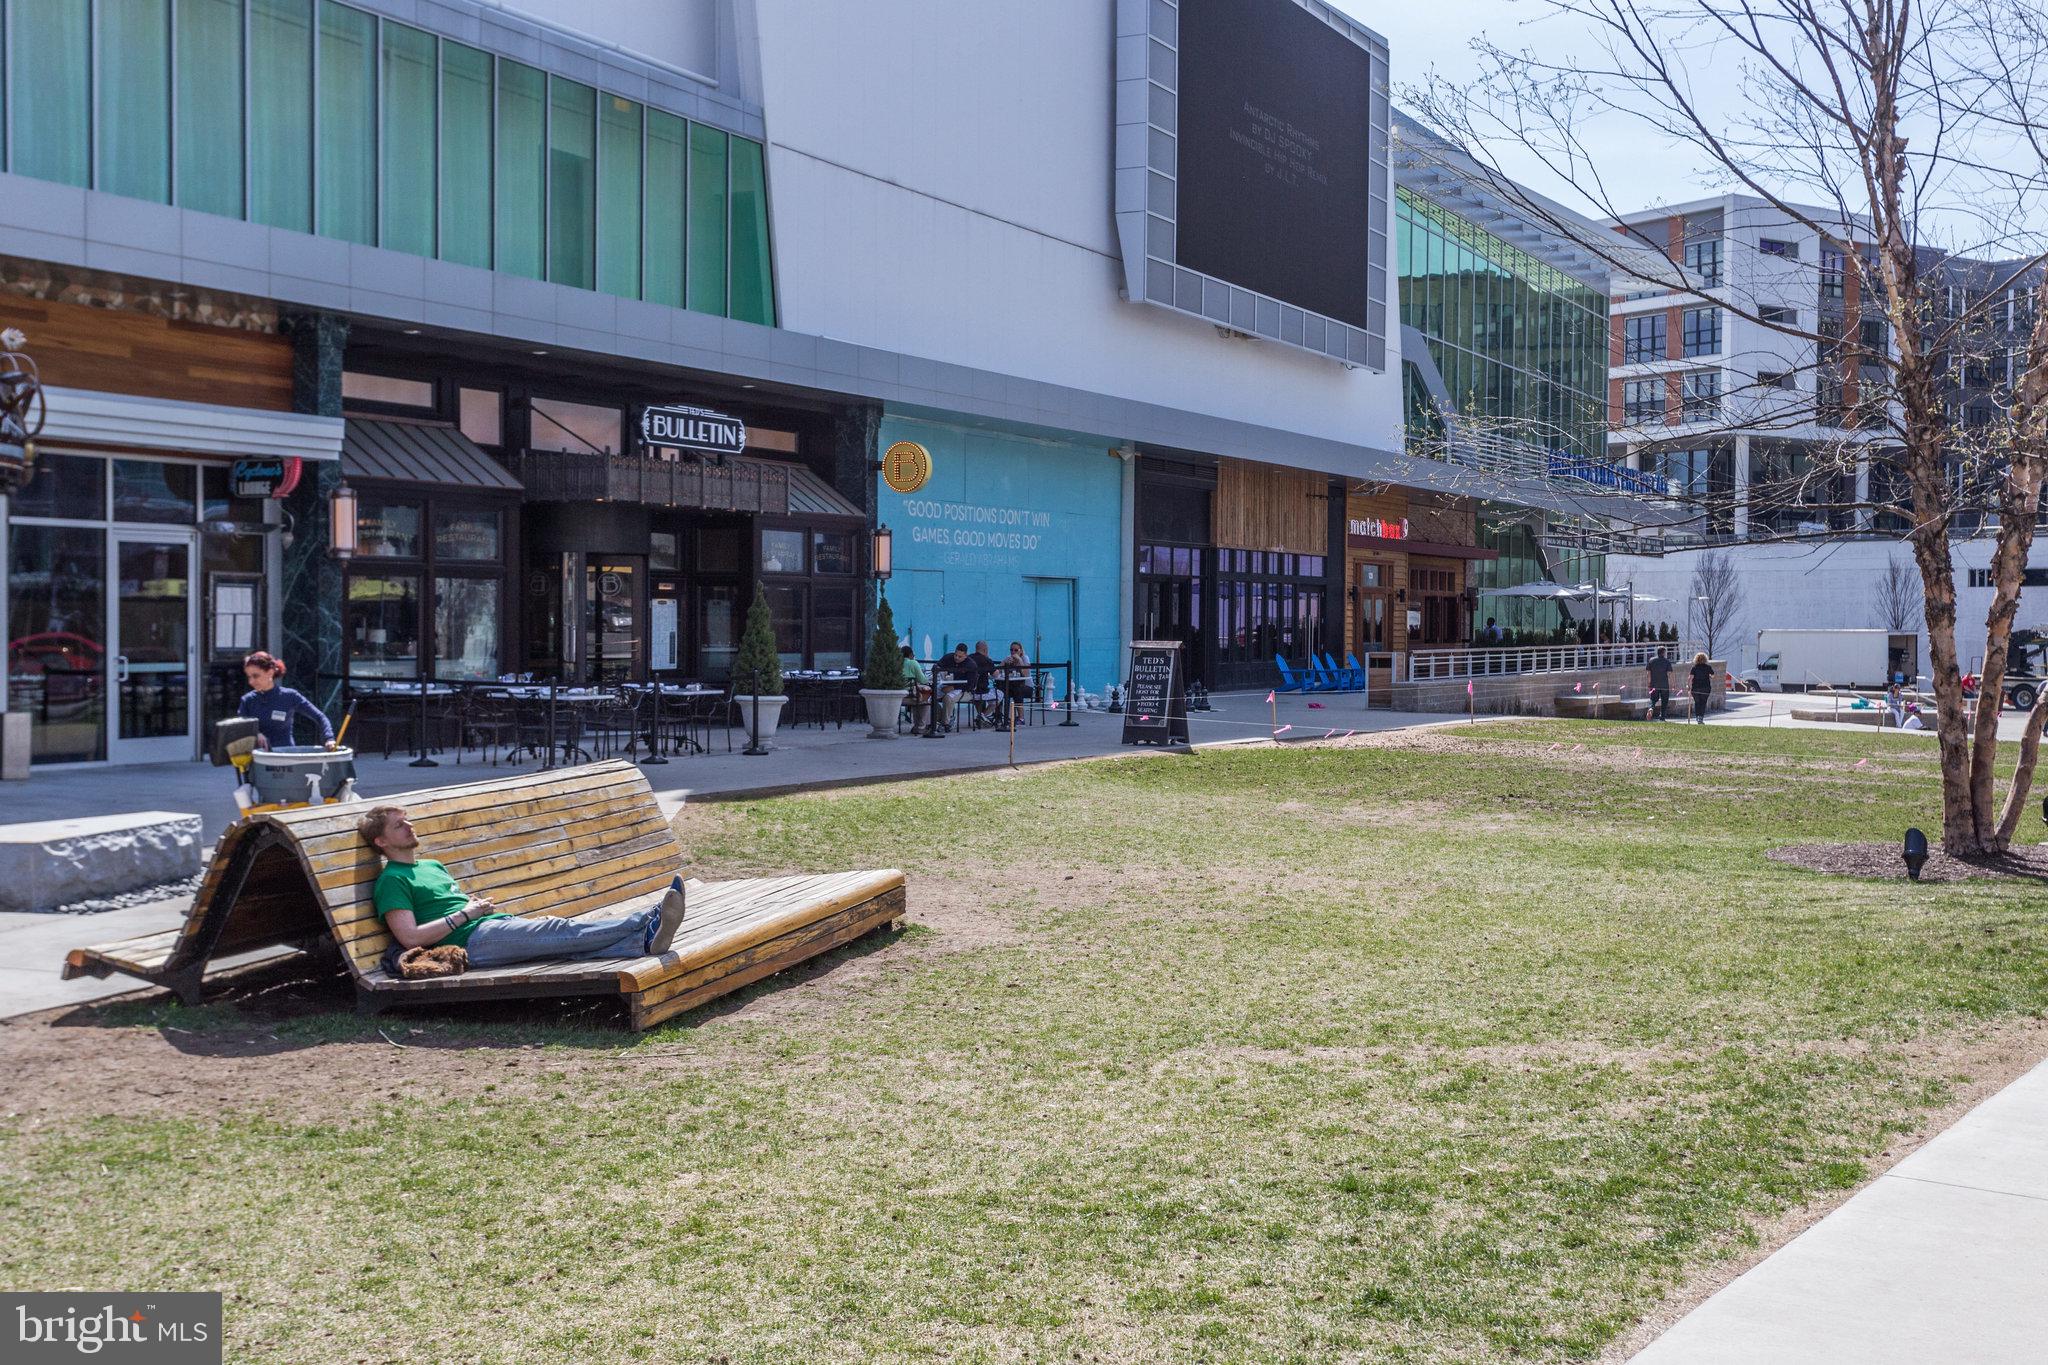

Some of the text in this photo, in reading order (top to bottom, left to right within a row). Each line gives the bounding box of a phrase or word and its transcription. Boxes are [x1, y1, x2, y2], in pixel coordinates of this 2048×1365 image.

[1279, 135, 1312, 160] SPOOKY
[653, 415, 736, 446] BULLETIN
[894, 451, 919, 482] B
[944, 503, 997, 524] POSITIONS
[1000, 508, 1030, 526] DON'T
[1032, 512, 1050, 528] WIN
[954, 530, 985, 547] GOOD
[987, 533, 1020, 549] MOVES
[1134, 665, 1171, 673] BULLETIN
[1136, 673, 1156, 681] OPEN
